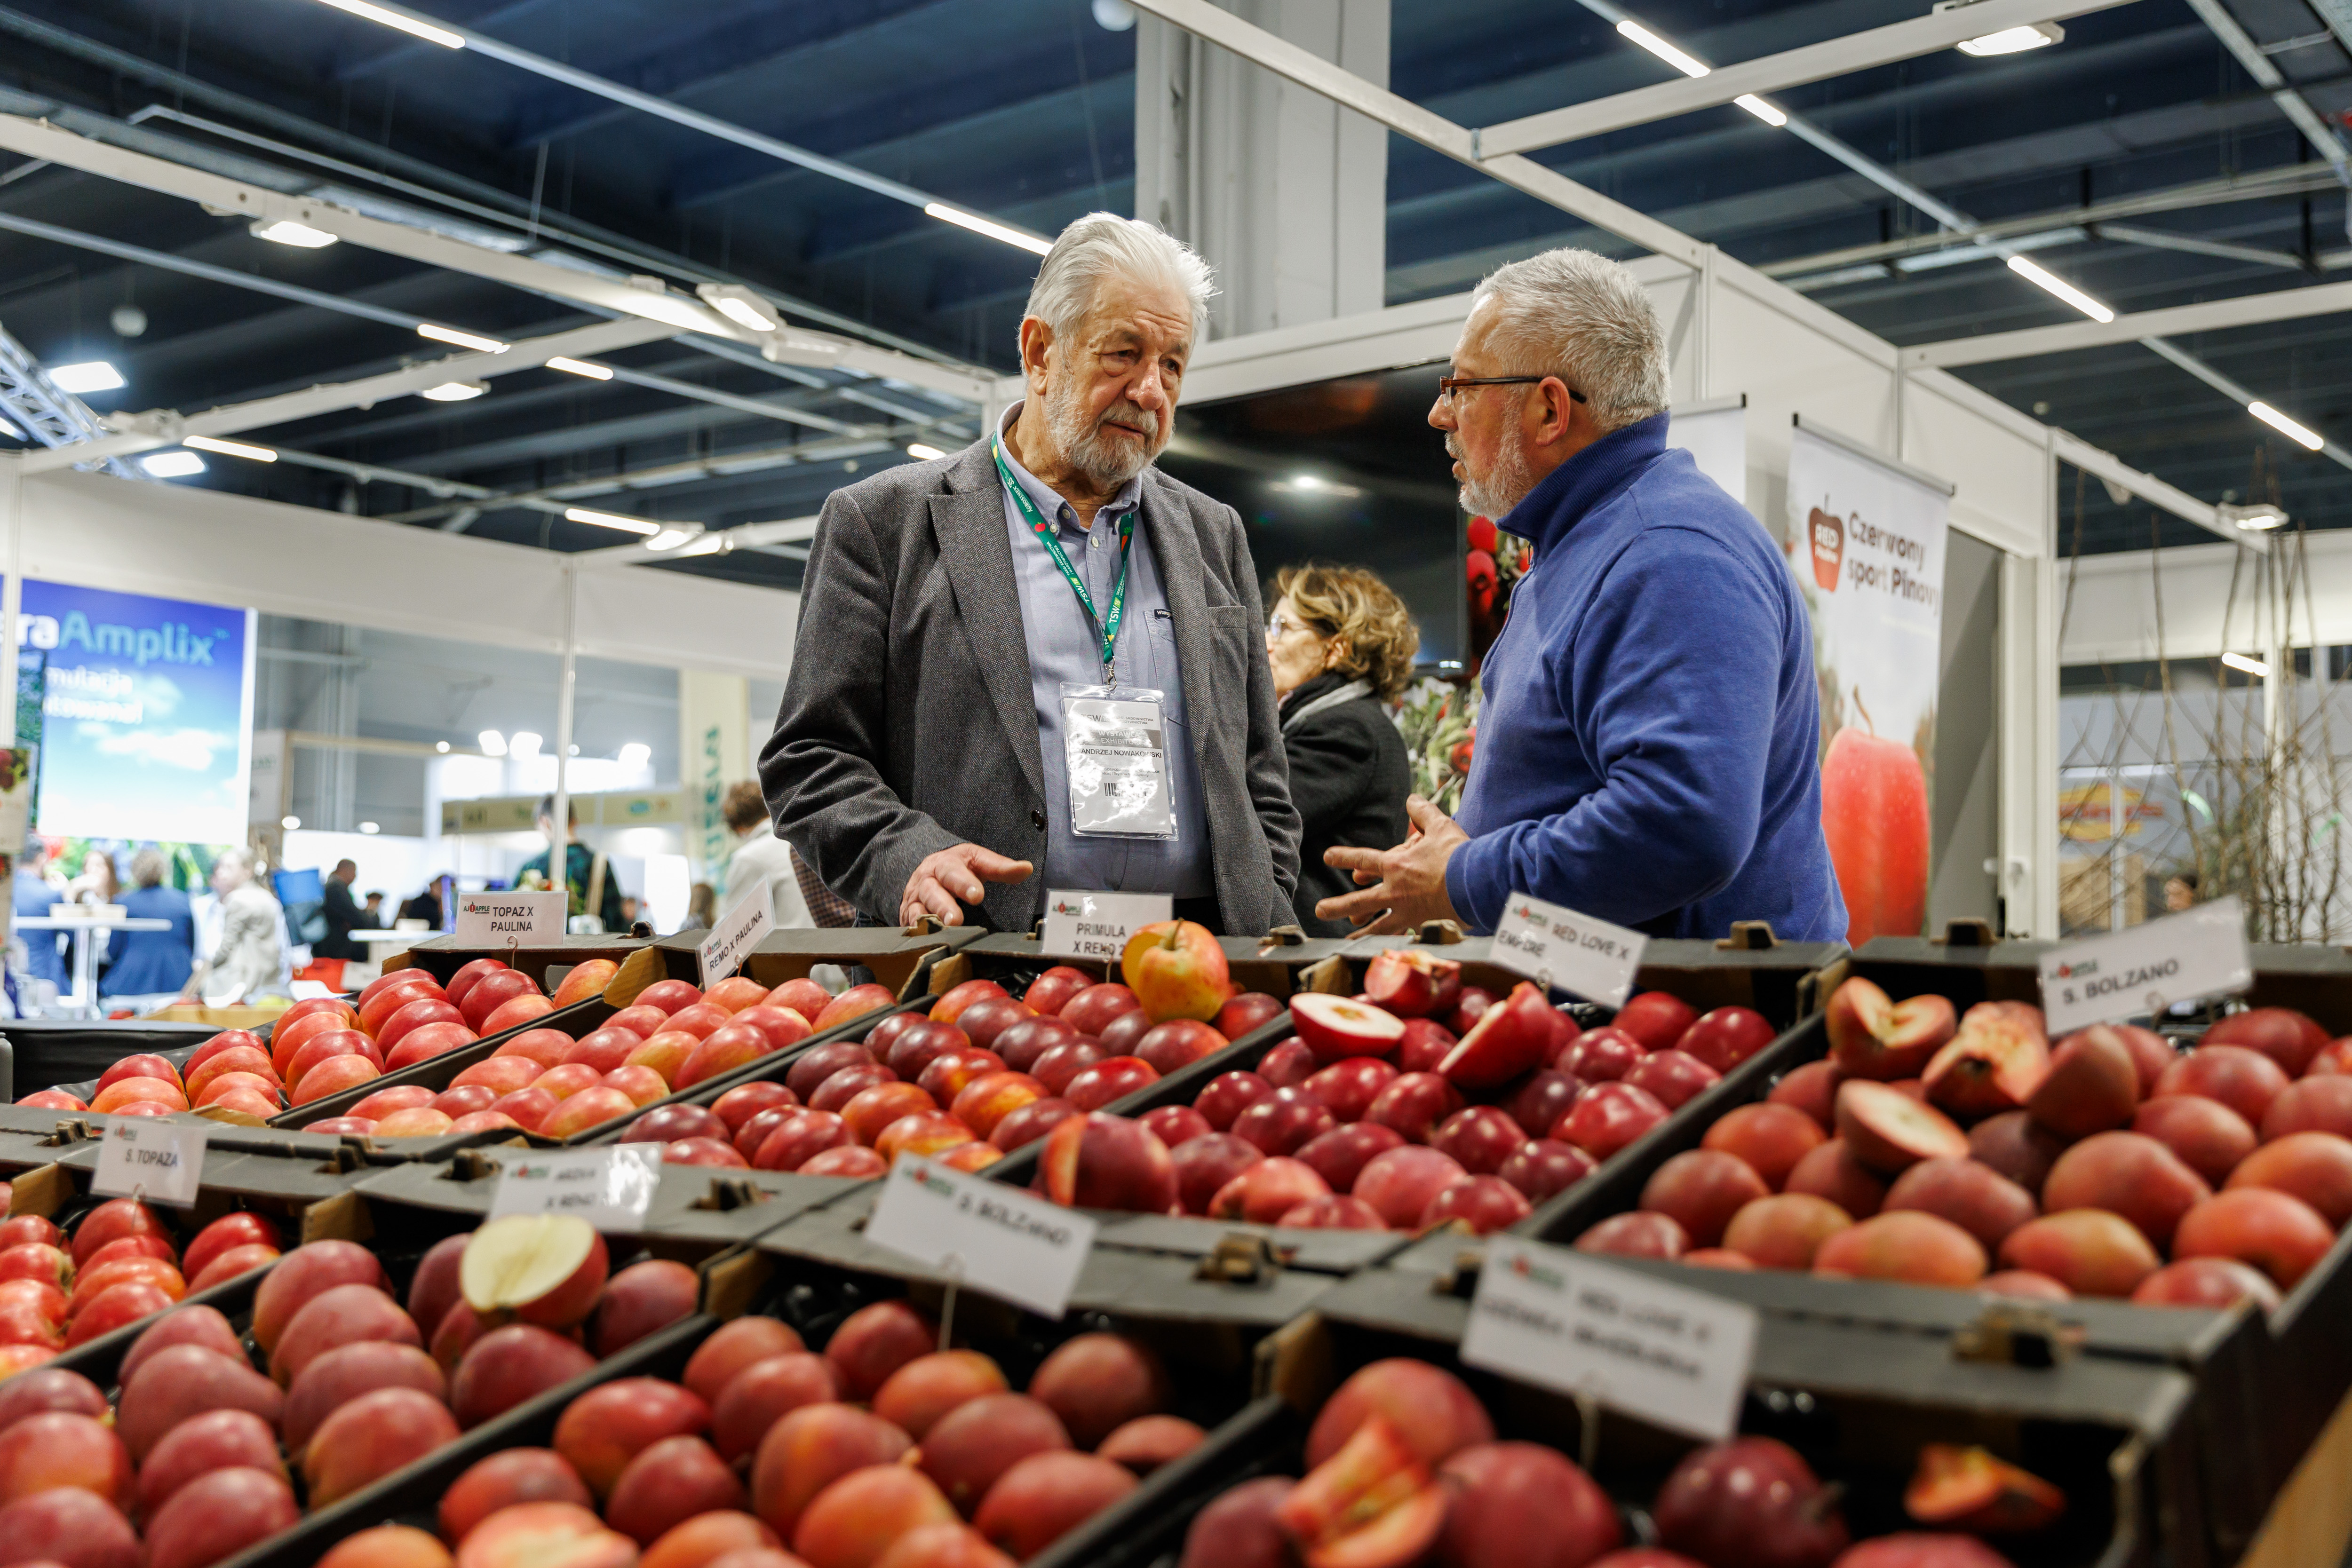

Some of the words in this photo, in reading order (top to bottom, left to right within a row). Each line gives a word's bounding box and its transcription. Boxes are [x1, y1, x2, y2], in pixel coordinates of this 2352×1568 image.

[1007, 477, 1014, 488] 35
[1013, 486, 1033, 512] AGROSIMEX
[1849, 512, 1925, 570] Czerwony
[1047, 541, 1064, 566] SADOWNICTWA
[1054, 545, 1073, 573] WARZYWNICTWA
[1848, 558, 1888, 591] sport
[1075, 586, 1089, 603] TSW
[1109, 605, 1120, 624] TSW
[493, 907, 524, 917] TOPAZ
[527, 906, 534, 916] X
[491, 921, 532, 932] PAULINA
[1077, 923, 1126, 937] PRIMULA
[709, 946, 729, 971] REMO
[730, 940, 735, 951] X
[735, 910, 763, 945] PAULINA
[1073, 941, 1080, 952] X
[2086, 958, 2179, 999] BOLZANO
[137, 1150, 178, 1167] TOPAZA
